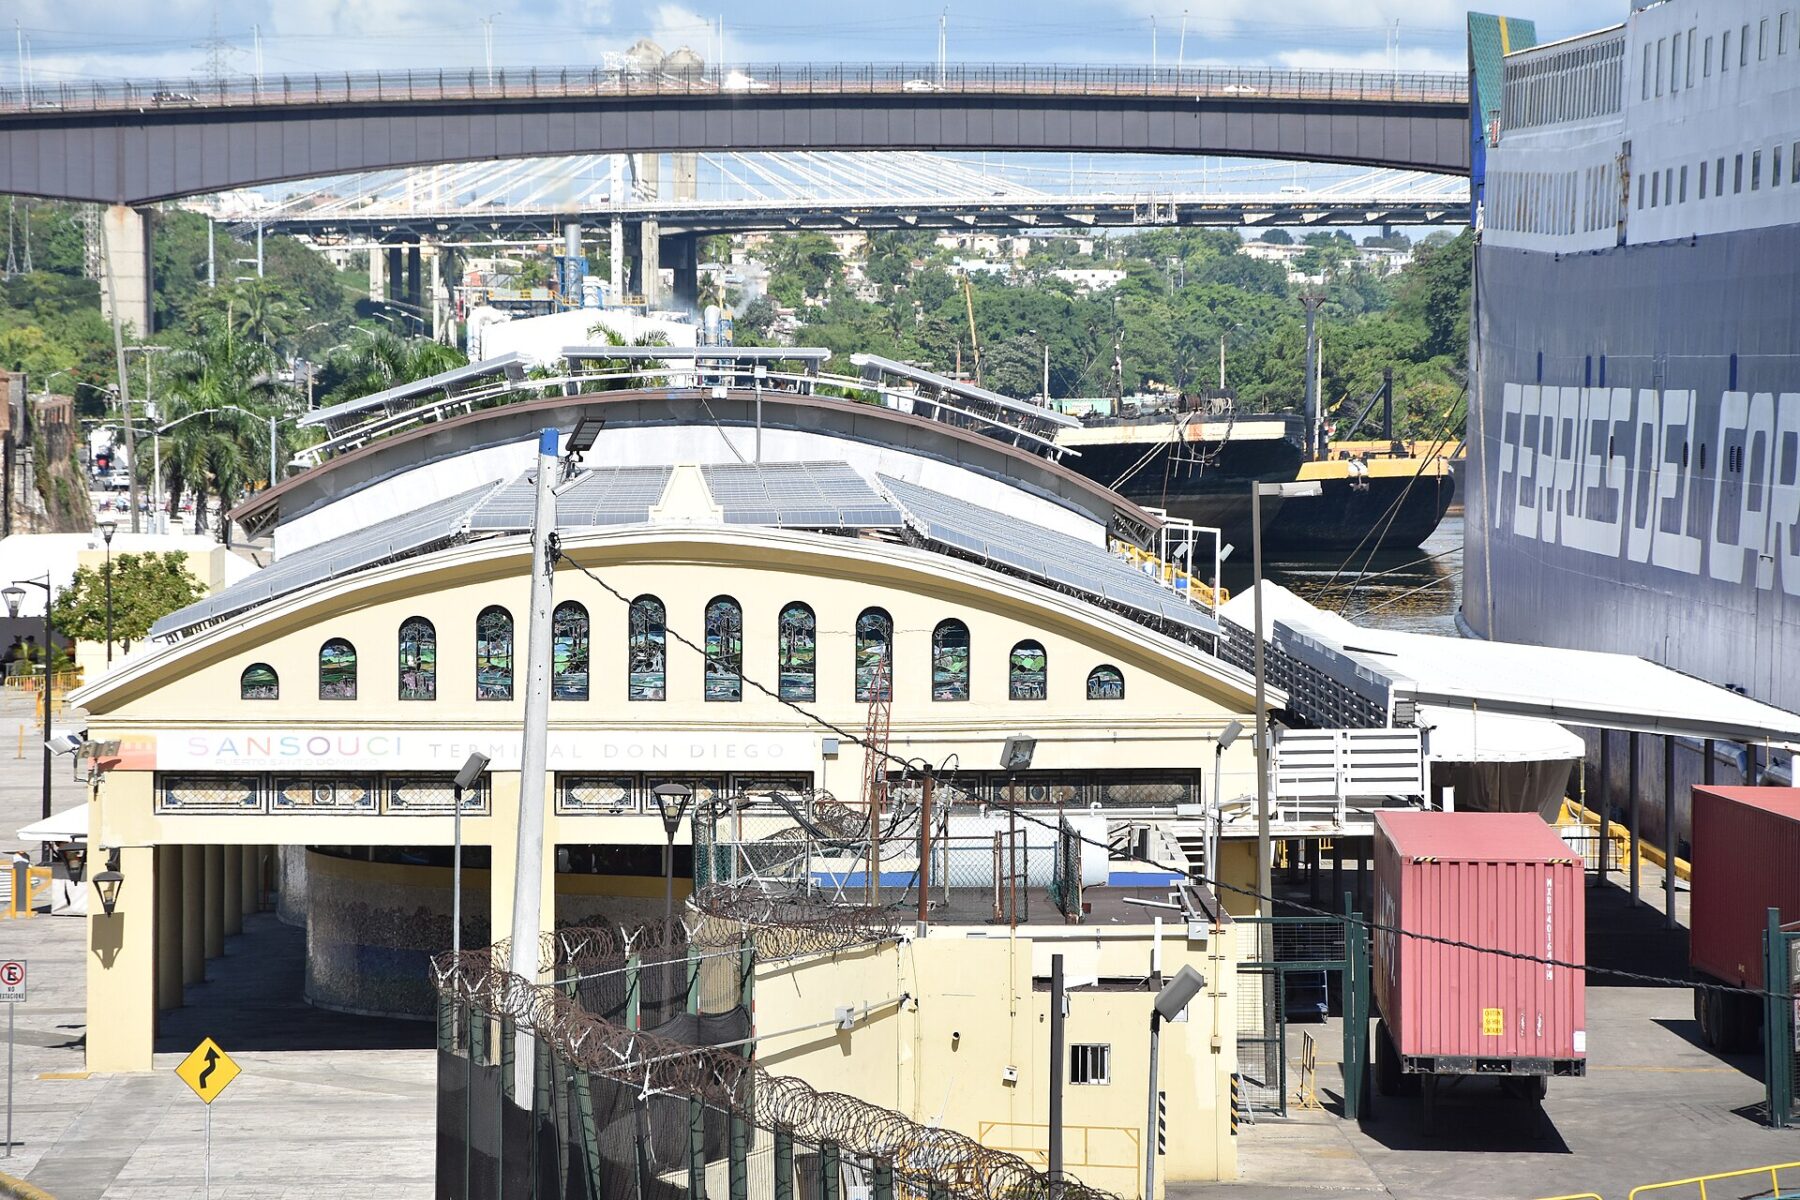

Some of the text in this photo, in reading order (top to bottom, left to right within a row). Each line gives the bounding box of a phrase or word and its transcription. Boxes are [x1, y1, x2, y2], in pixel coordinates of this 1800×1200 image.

[1495, 382, 1631, 559] FERRIES
[1628, 388, 1702, 575] DEL
[187, 736, 401, 756] SANSOUCI
[428, 743, 786, 759] TERMIAL DON DIEGO
[215, 758, 267, 766] PUERTO
[271, 758, 314, 766] SANTO
